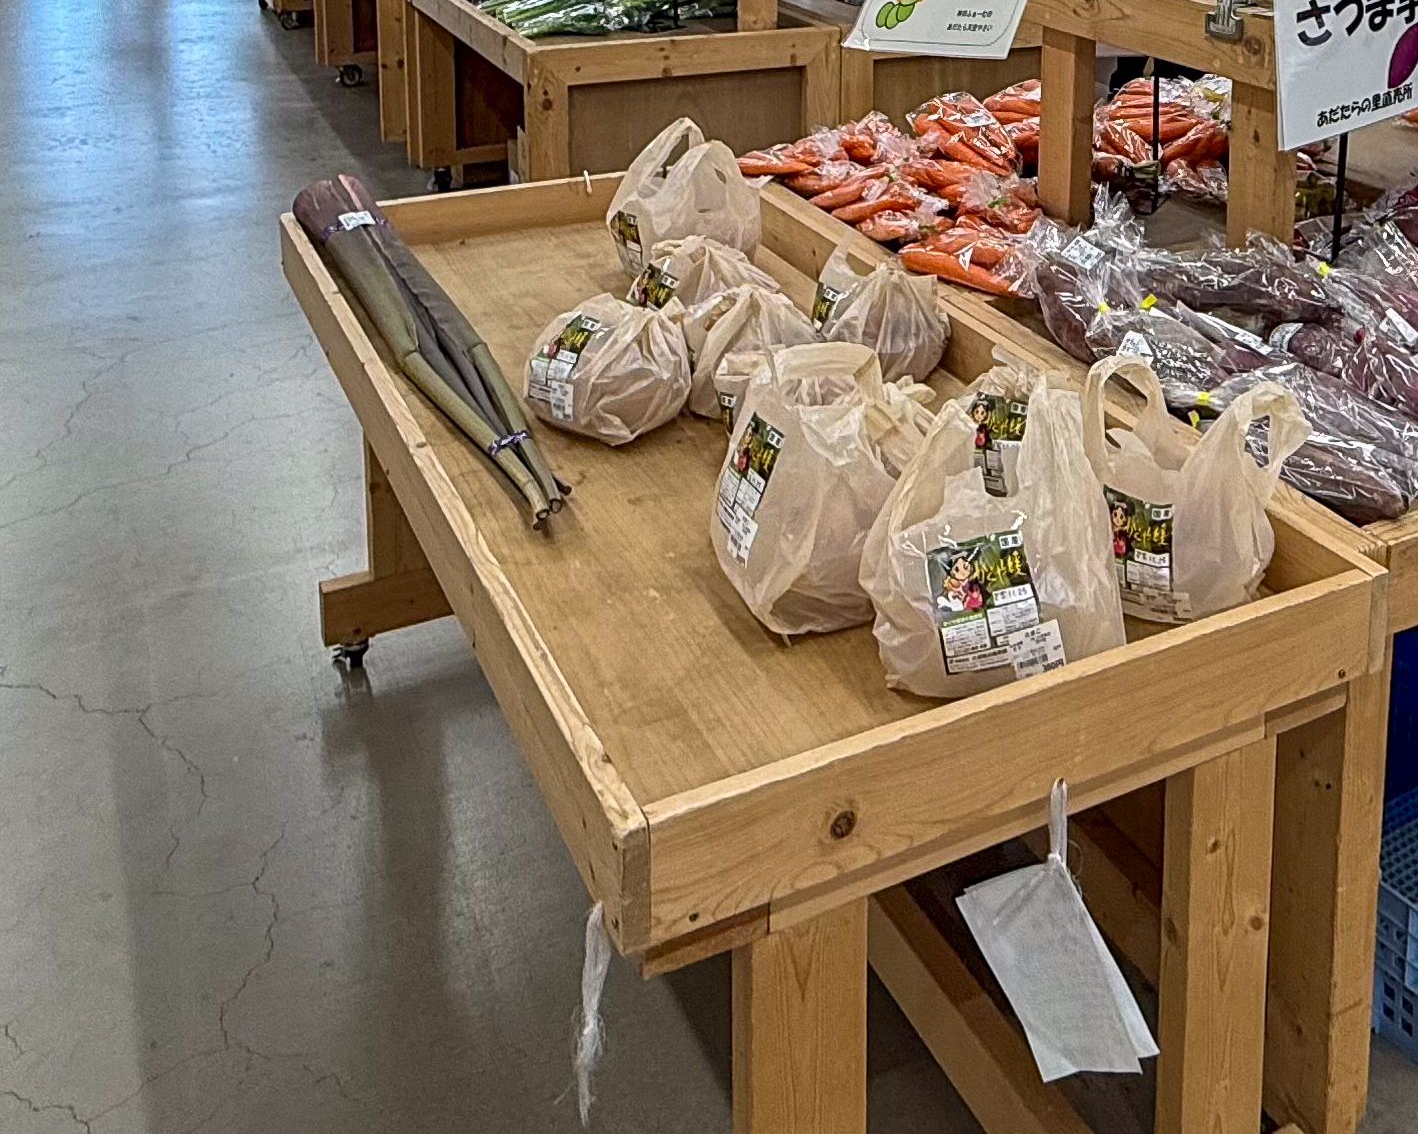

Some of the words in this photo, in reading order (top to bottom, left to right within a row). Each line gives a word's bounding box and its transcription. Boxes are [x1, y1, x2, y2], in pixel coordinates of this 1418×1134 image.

[1316, 82, 1414, 128] あだたらの里直売所
